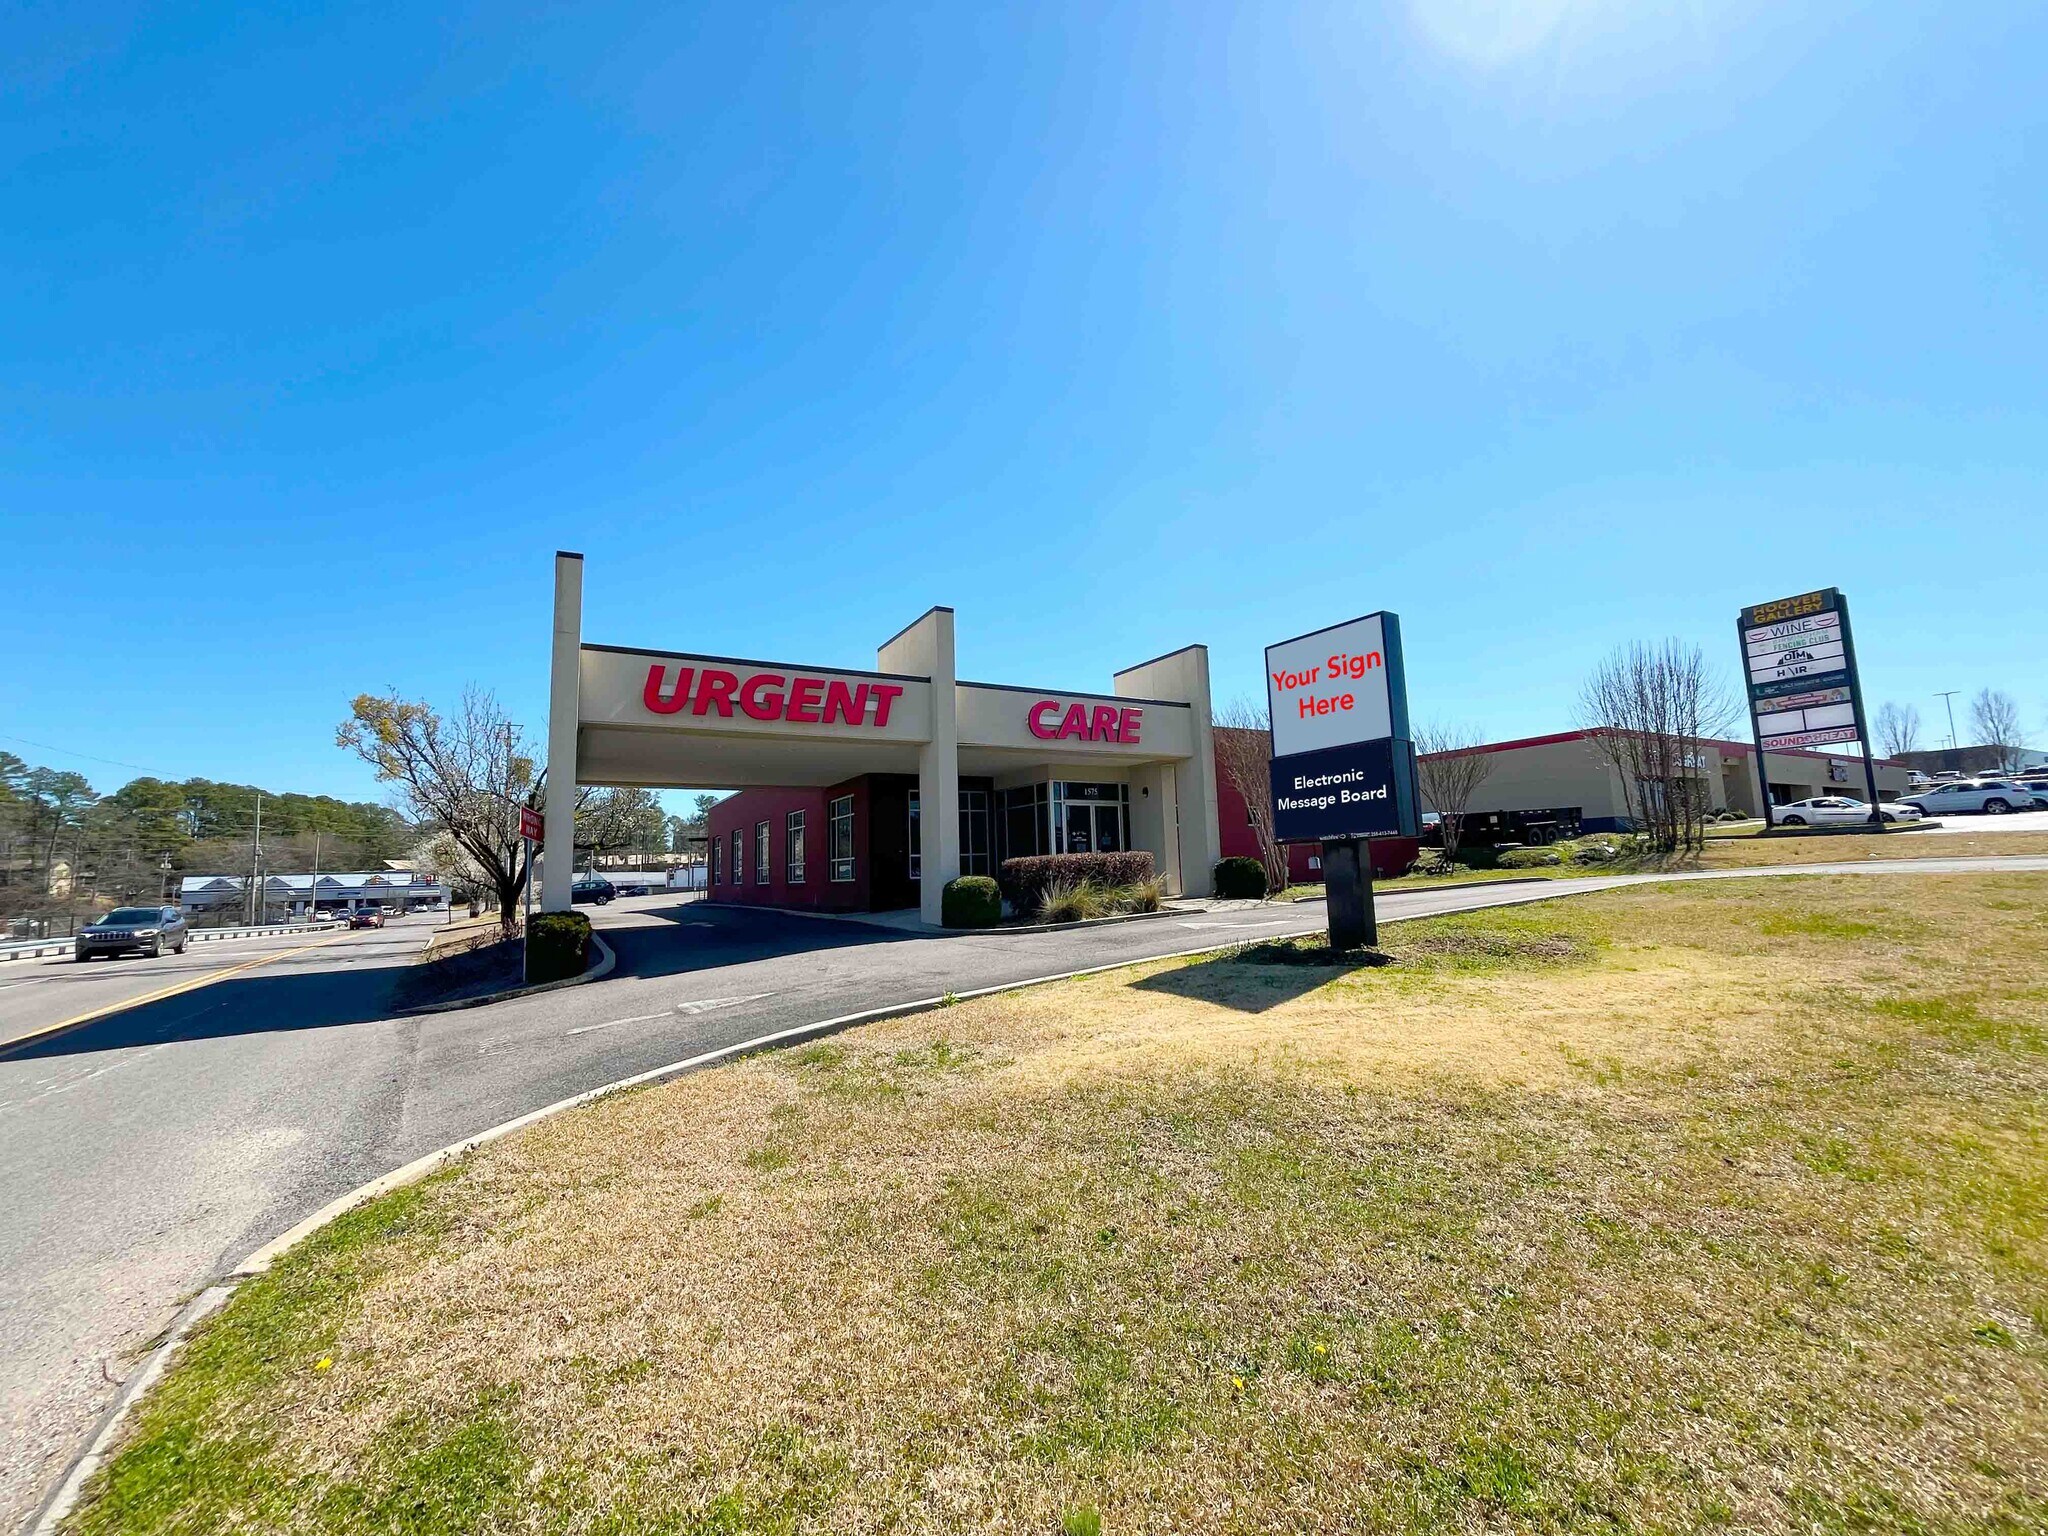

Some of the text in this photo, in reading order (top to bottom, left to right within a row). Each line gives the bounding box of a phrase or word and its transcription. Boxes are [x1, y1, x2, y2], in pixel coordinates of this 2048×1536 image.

[1754, 604, 1823, 623] GALLERY
[1755, 594, 1822, 614] HOOVER
[1770, 620, 1813, 636] WINE
[1773, 635, 1830, 651] FENCING CLUB
[1784, 650, 1806, 661] OTM
[1272, 651, 1381, 691] Your Sign
[643, 664, 1144, 744] URGENT CARE
[1299, 693, 1354, 719] Here
[1294, 768, 1364, 790] Electronic
[1084, 787, 1098, 796] 1575
[1278, 784, 1387, 810] Message Board
[525, 824, 538, 837] WAY
